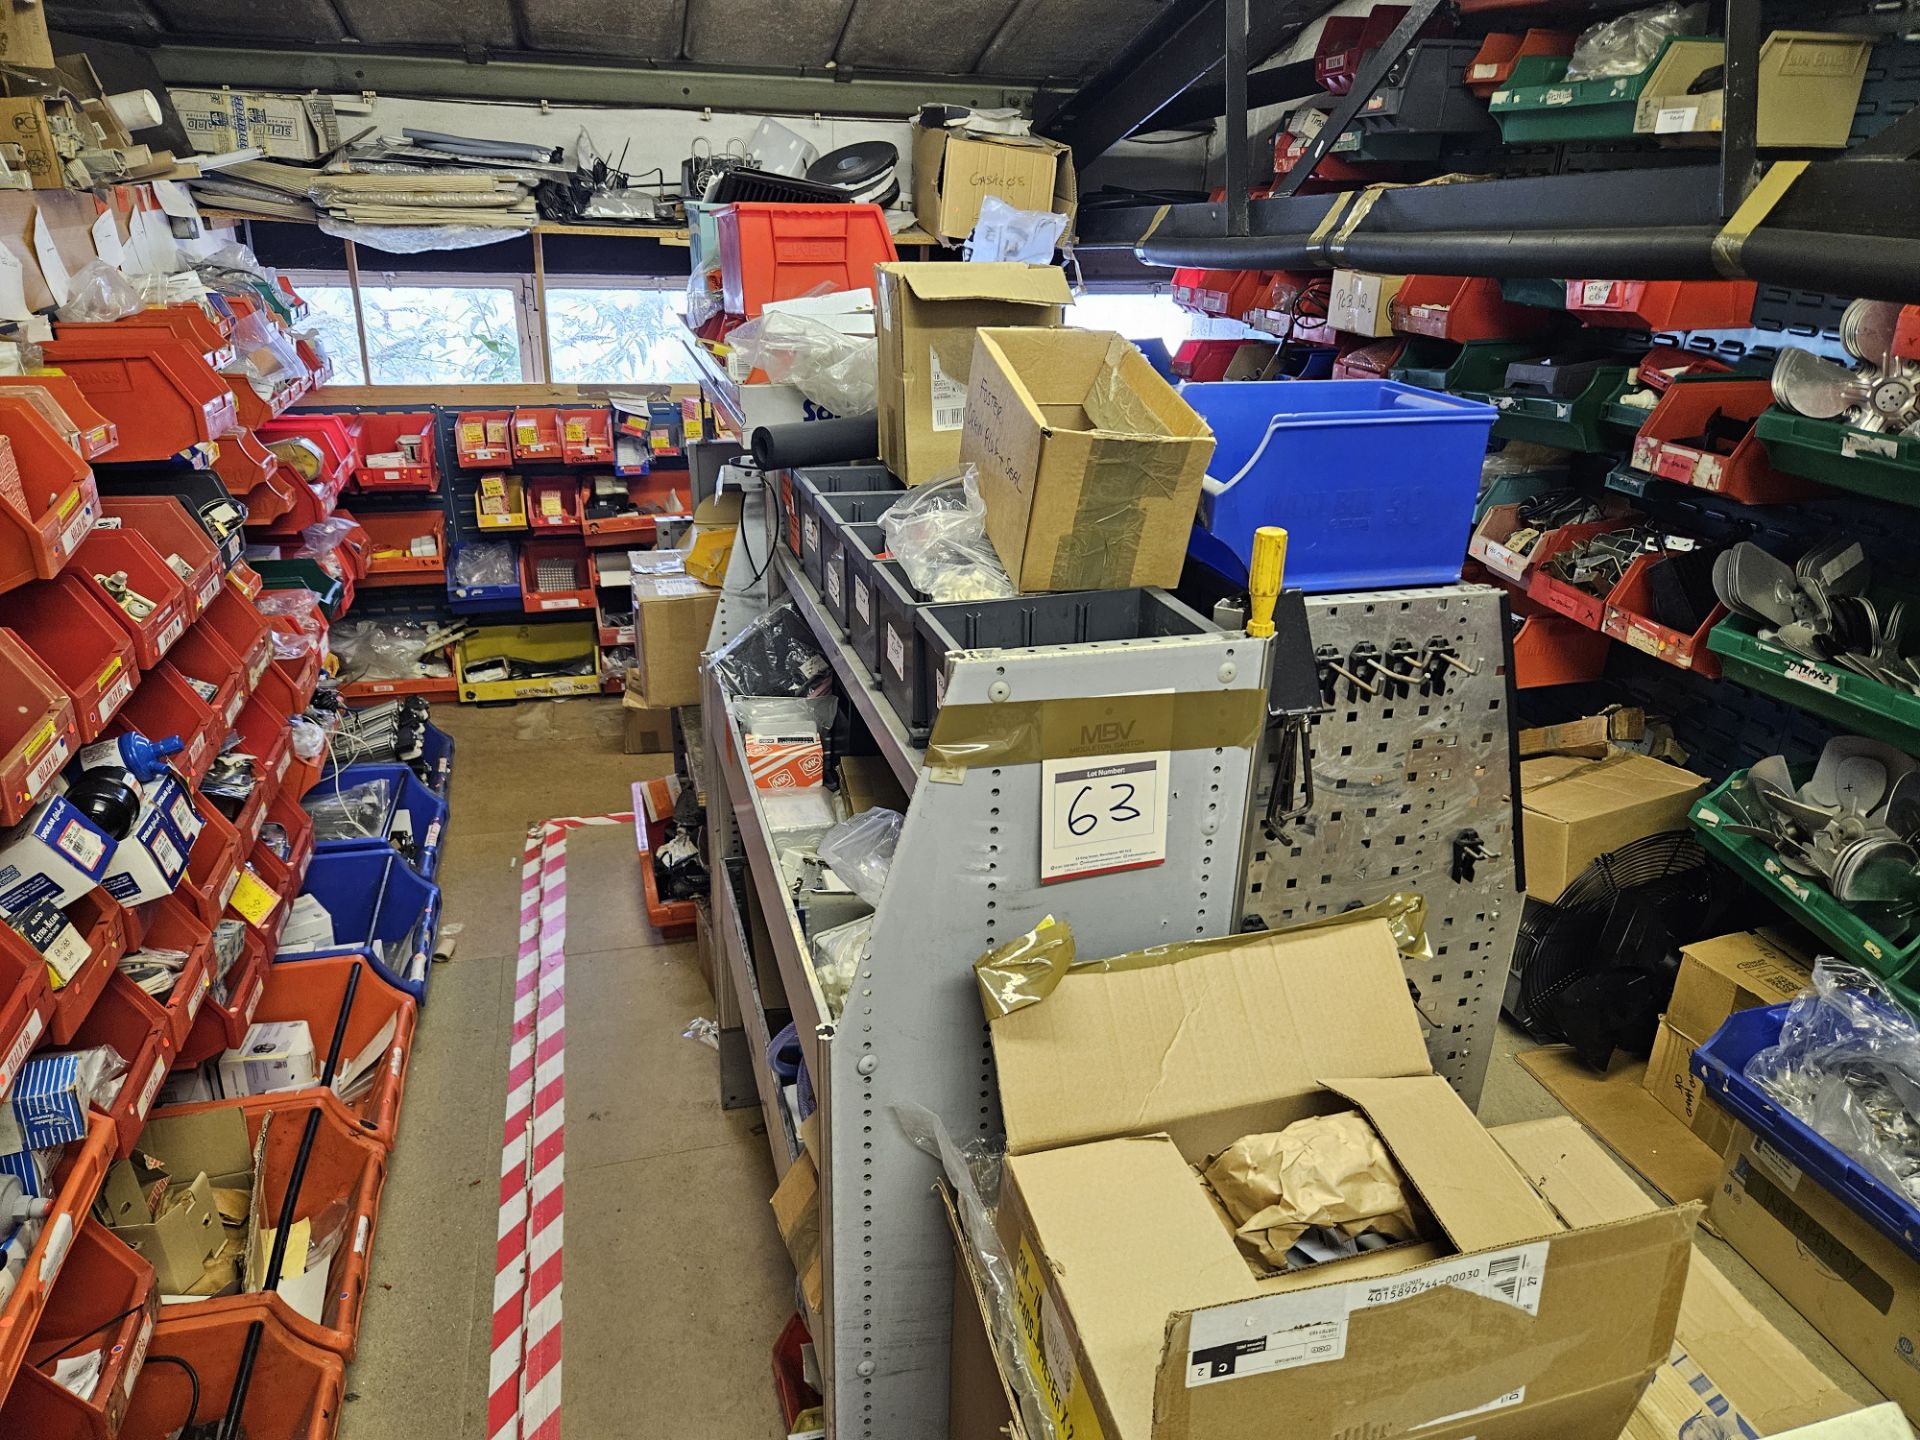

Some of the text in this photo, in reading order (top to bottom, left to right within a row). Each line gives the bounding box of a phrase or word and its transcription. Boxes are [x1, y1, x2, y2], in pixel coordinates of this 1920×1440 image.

[1080, 719, 1137, 745] MBV
[1086, 766, 1126, 778] Lot Number:
[1067, 783, 1142, 836] 63
[41, 816, 56, 842] SPORLAN
[30, 911, 43, 925] ALCO
[1367, 1268, 1480, 1303] 4015896744-00030
[1197, 1367, 1205, 1377] 2
[1218, 1362, 1228, 1373] C
